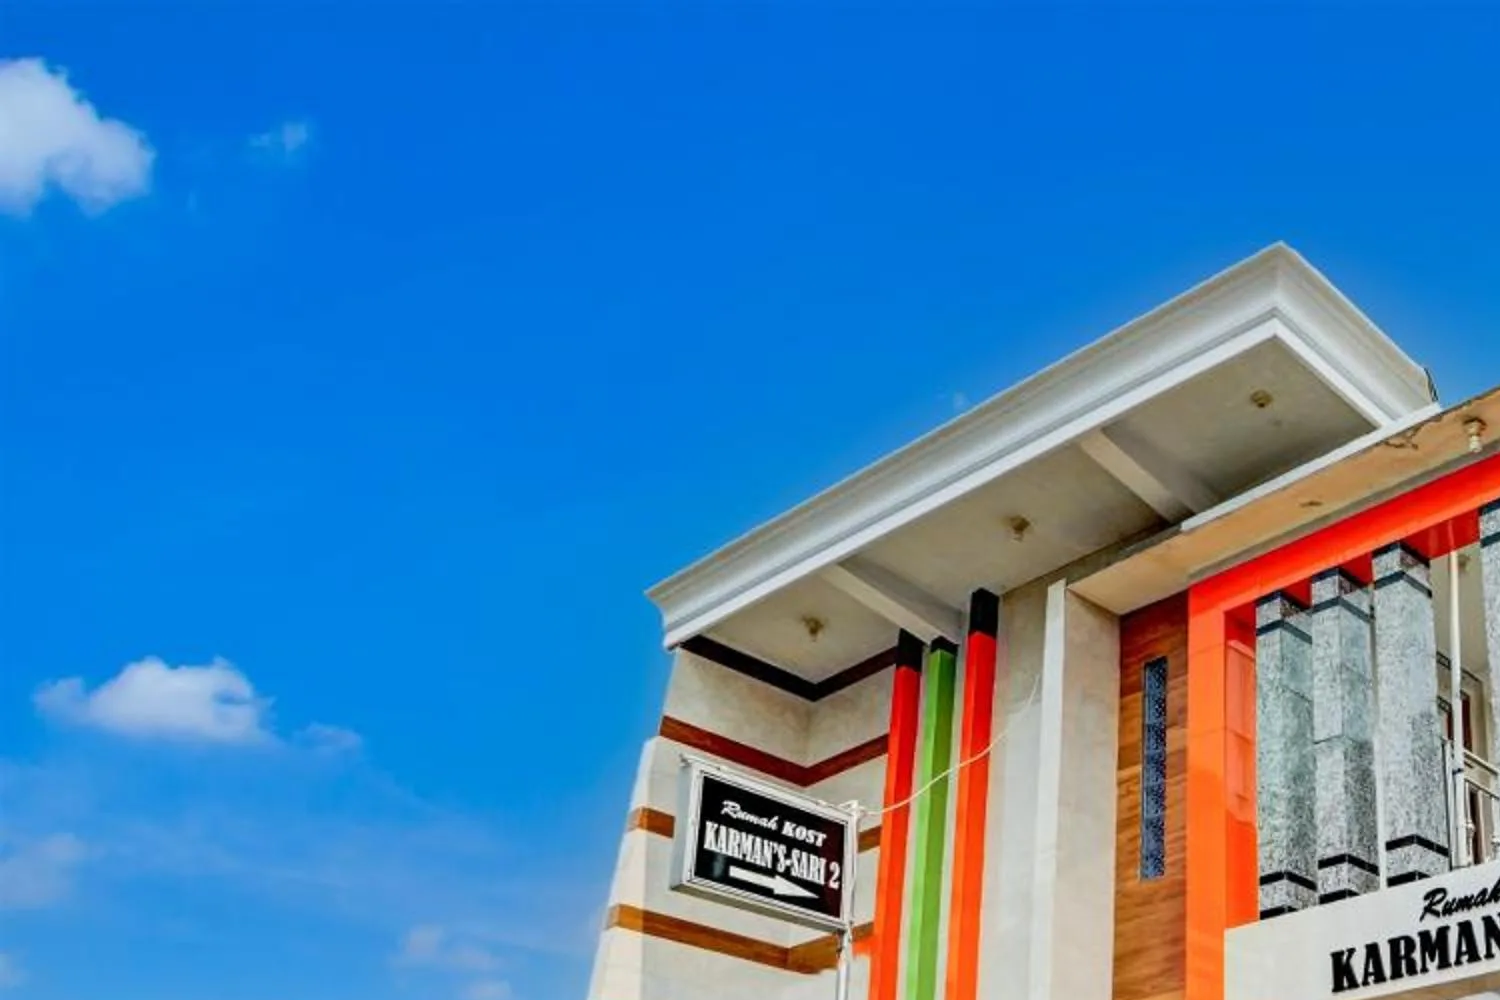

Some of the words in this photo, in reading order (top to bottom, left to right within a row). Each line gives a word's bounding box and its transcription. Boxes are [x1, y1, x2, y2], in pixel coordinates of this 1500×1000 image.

[721, 800, 778, 830] Rumah
[781, 821, 827, 847] KOST
[828, 861, 840, 890] 2
